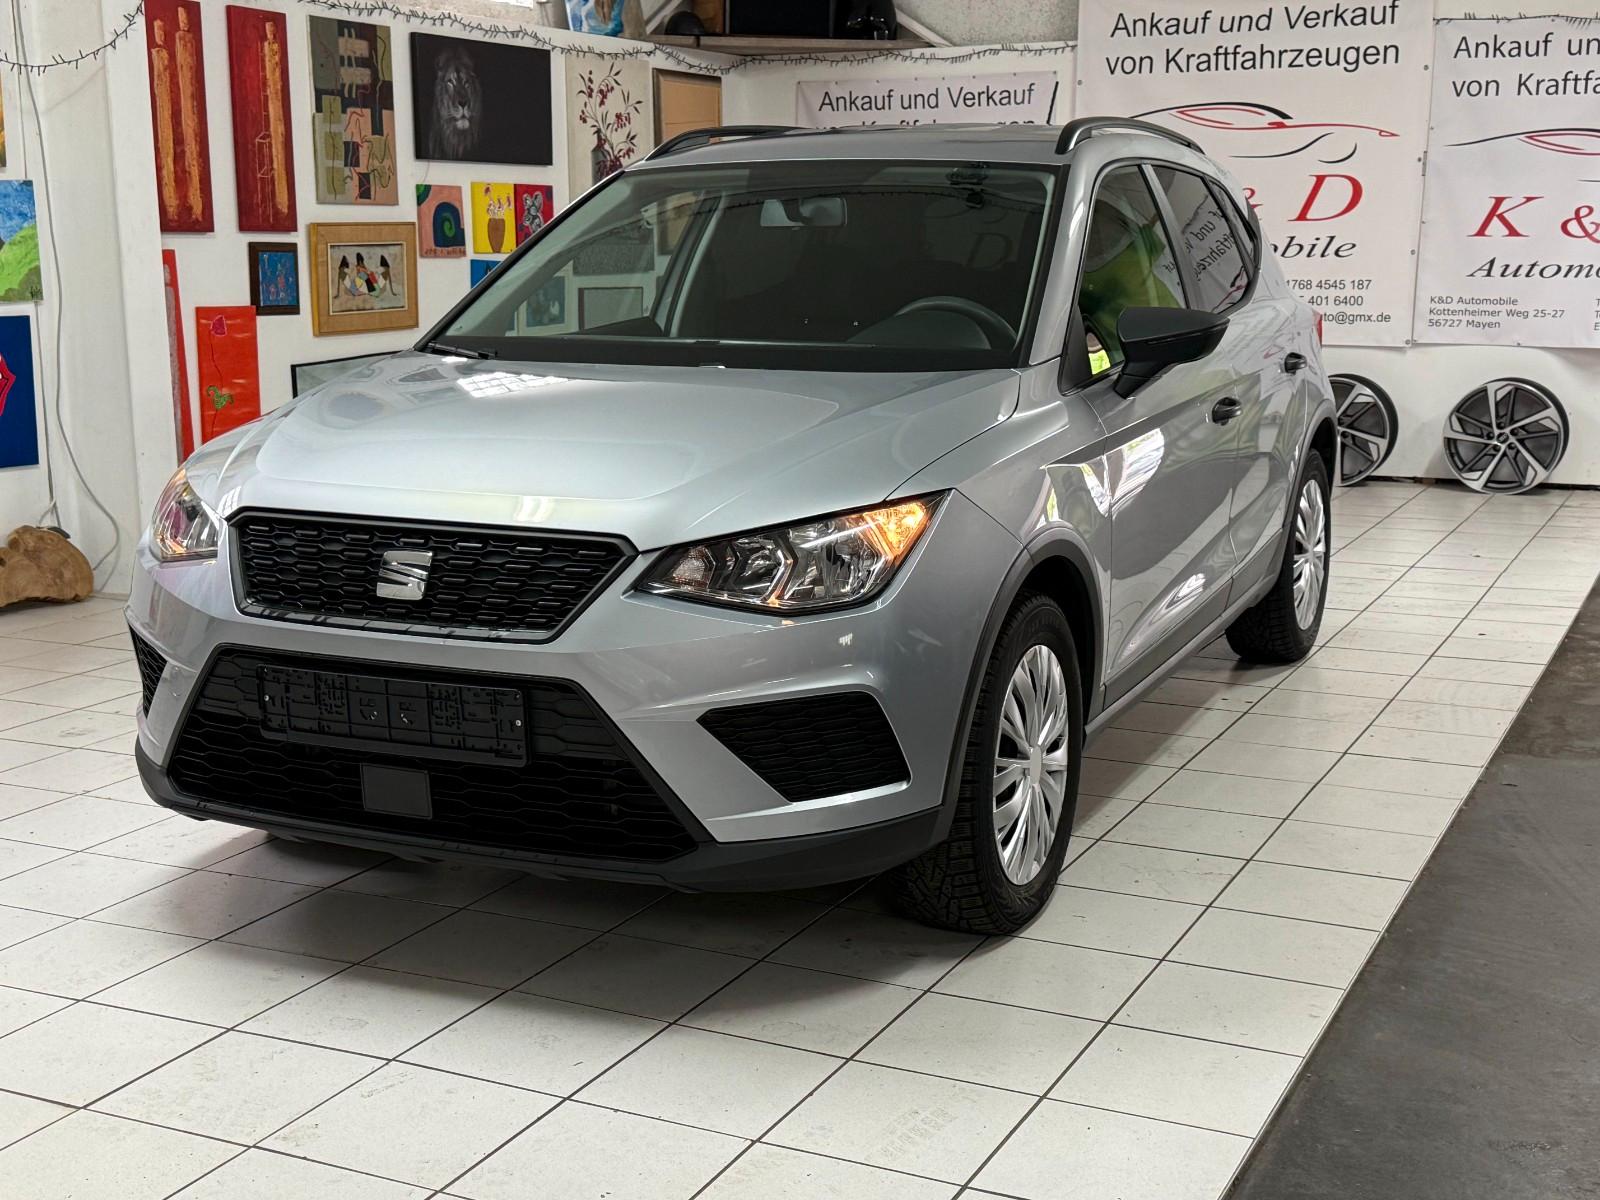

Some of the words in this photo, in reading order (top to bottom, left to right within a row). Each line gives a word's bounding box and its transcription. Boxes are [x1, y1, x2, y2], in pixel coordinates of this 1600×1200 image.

[1110, 10, 1213, 38] Ankauf
[1219, 8, 1273, 33] und
[1284, 0, 1401, 29] Verkauf
[1453, 32, 1554, 59] Ankauf
[1105, 54, 1155, 75] von
[1165, 43, 1400, 73] Kraftfahrzeugen
[818, 88, 894, 112] Ankauf
[900, 88, 939, 110] und
[947, 82, 1036, 107] Verkauf
[1452, 79, 1500, 97] von
[1287, 174, 1364, 222] D
[1466, 196, 1545, 238] K
[1465, 257, 1600, 279] Autom
[1315, 279, 1346, 290] 4545
[1350, 279, 1372, 290] 187
[1307, 295, 1330, 306] 401
[1333, 295, 1364, 306] 6400
[1430, 296, 1454, 305] K&D
[1457, 297, 1519, 306] Automobile
[1428, 319, 1463, 328] 56727
[1466, 320, 1501, 330] Mayen
[1429, 308, 1502, 317] Kottenheimer
[1506, 309, 1530, 319] Weg
[1533, 309, 1566, 319] 25-27
